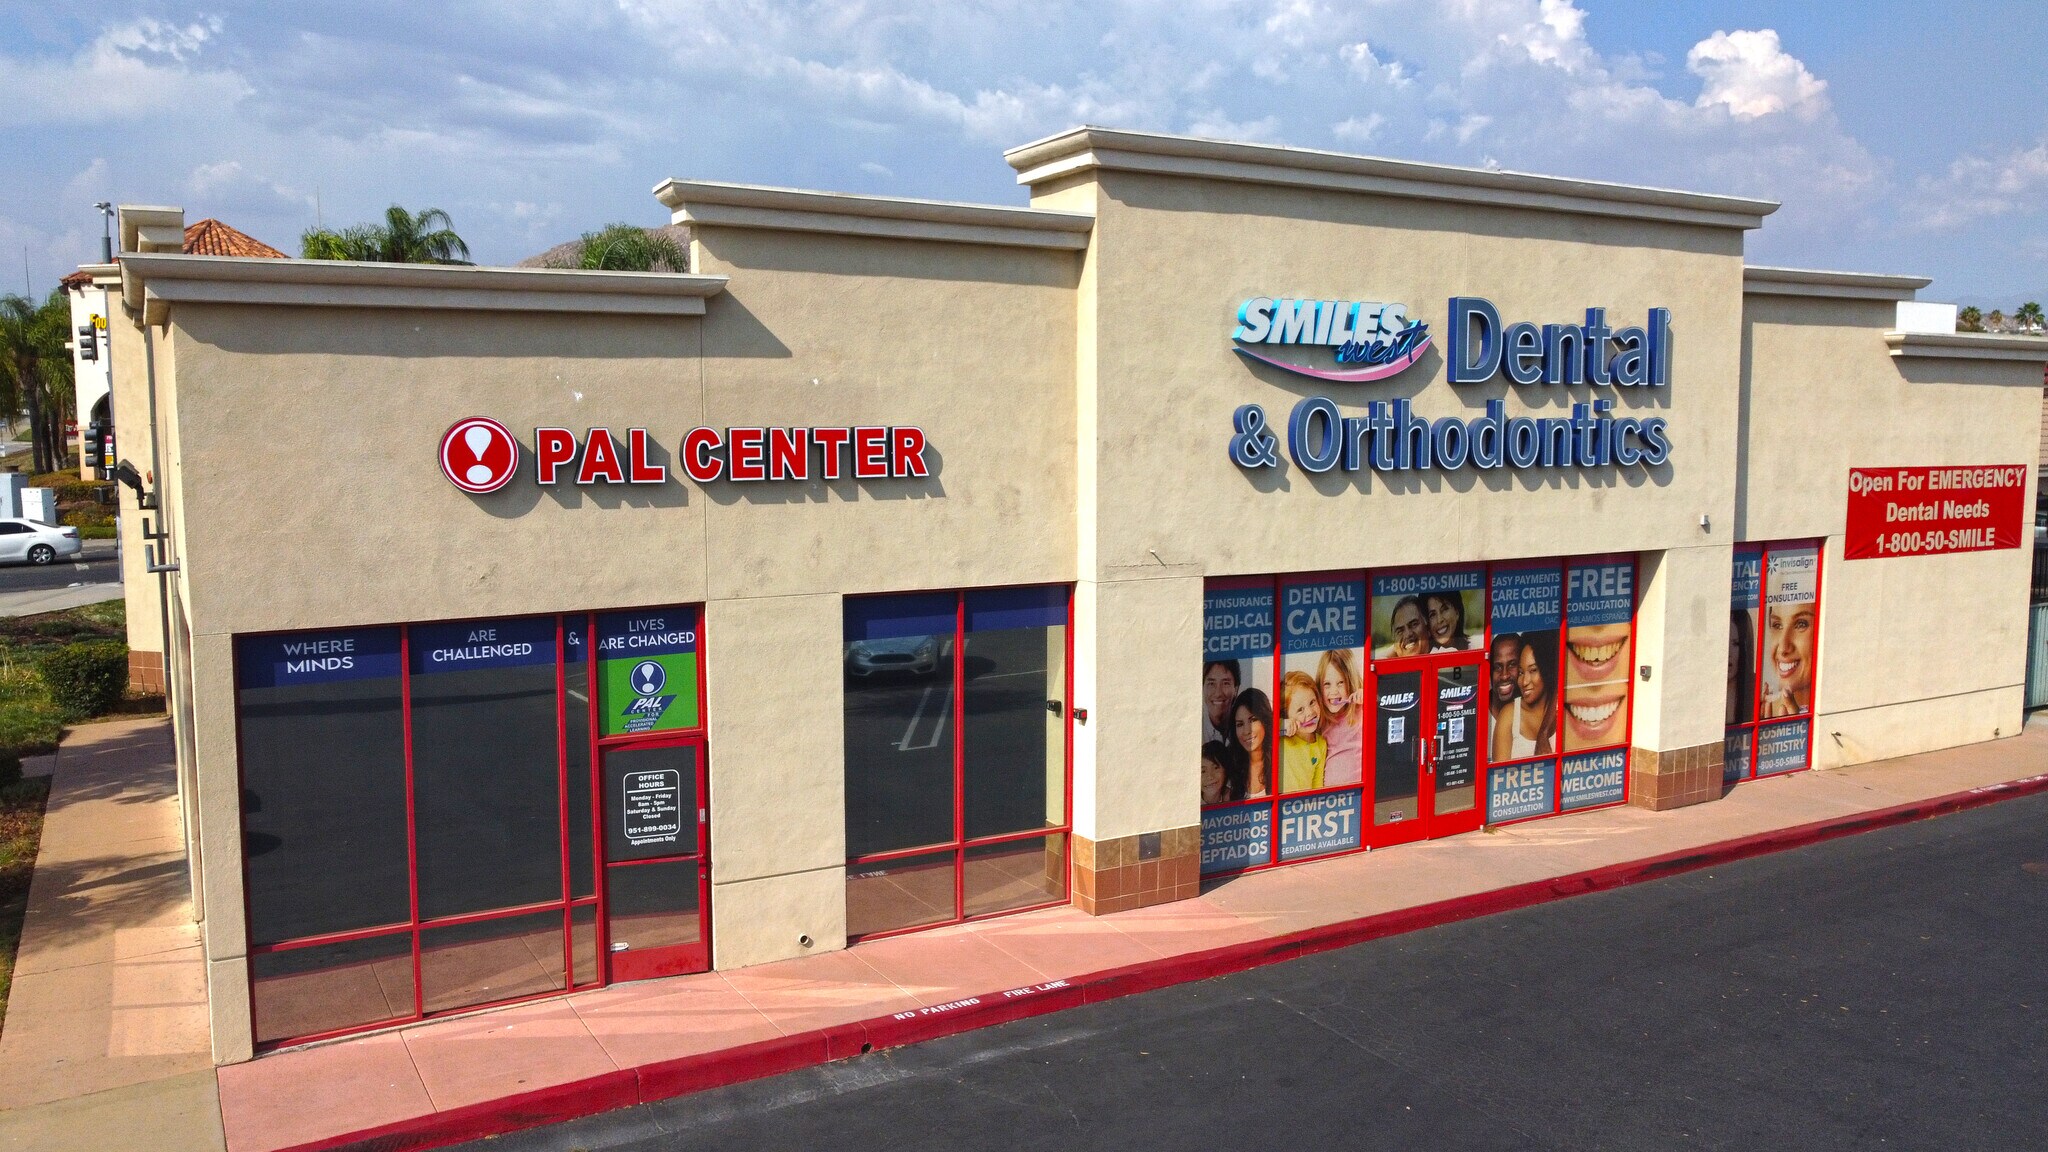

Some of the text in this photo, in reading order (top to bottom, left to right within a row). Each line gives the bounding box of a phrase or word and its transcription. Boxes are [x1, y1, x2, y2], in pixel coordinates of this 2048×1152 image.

[1232, 296, 1407, 345] SMILES
[1339, 320, 1428, 364] west
[1447, 296, 1670, 386] Dental
[1229, 395, 1669, 473] & Orthodontics
[533, 425, 929, 485] PAL CENTER
[1850, 468, 2025, 496] Open For EMERGENCY
[1886, 499, 1990, 522] Dental Needs
[1876, 528, 1995, 554] 1-800-50-SMILE
[1732, 560, 1759, 578] TAL
[1780, 557, 1813, 568] invisalign
[1378, 573, 1478, 593] 1-800-50-SMILE
[1492, 573, 1560, 587] EASY PAYMENTS
[1567, 566, 1631, 599] FREE
[1782, 582, 1798, 591] FREE
[1216, 596, 1272, 608] INSURANCE
[1288, 585, 1355, 606] DENTAL
[1492, 586, 1560, 601] CARE CREDIT
[1491, 600, 1559, 619] AVAILABLE
[1567, 599, 1630, 612] CONSULTATION
[628, 618, 665, 632] LIVES
[1204, 612, 1272, 630] MEDI-CAL
[1287, 606, 1356, 635] CARE
[468, 629, 497, 643] ARE
[568, 631, 580, 645] &
[599, 631, 695, 650] ARE CHANGED
[1288, 635, 1354, 650] FOR ALL AGES
[283, 639, 355, 656] WHERE
[432, 643, 532, 662] CHALLENGED
[287, 656, 354, 674] MINDS
[1453, 667, 1462, 680] B
[1380, 692, 1414, 707] SMILES
[1440, 686, 1472, 700] SMILES
[633, 696, 662, 710] PAL
[1562, 753, 1623, 776] WALK-INS
[1493, 763, 1544, 791] FREE
[1561, 771, 1623, 793] WELCOME
[1282, 792, 1355, 816] COMFORT
[1493, 786, 1544, 808] BRACES
[1492, 802, 1544, 818] CONSULTATION
[628, 824, 676, 834] 951-899-0034
[1202, 810, 1268, 830] MAYORÍA DE
[1281, 809, 1354, 844] FIRST
[631, 837, 664, 846] Appointments
[1208, 825, 1268, 845] SEGUROS
[1200, 841, 1268, 864] EPTADOS
[1281, 836, 1354, 856] SEDATION AVAILABLE
[894, 980, 1070, 1021] NO PARKING FIRE LANE
